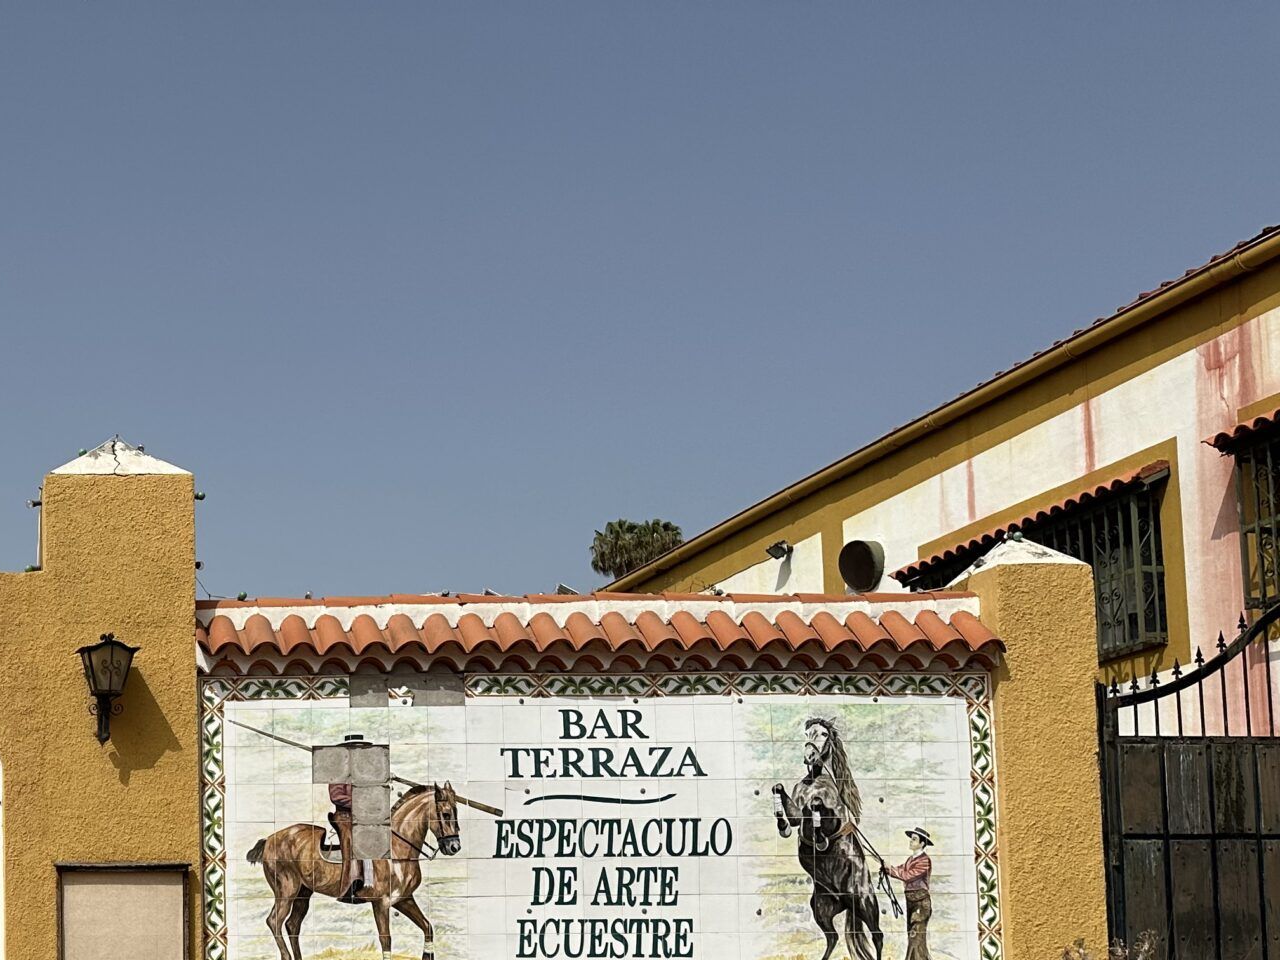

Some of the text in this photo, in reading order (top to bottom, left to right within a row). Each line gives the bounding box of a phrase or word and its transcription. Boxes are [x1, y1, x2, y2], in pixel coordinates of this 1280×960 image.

[558, 708, 650, 740] BAR
[500, 746, 709, 778] TERRAZA
[492, 817, 734, 859] ESPECTACULO
[530, 866, 680, 907] DE ARTE
[515, 917, 695, 959] ECUESTRE
